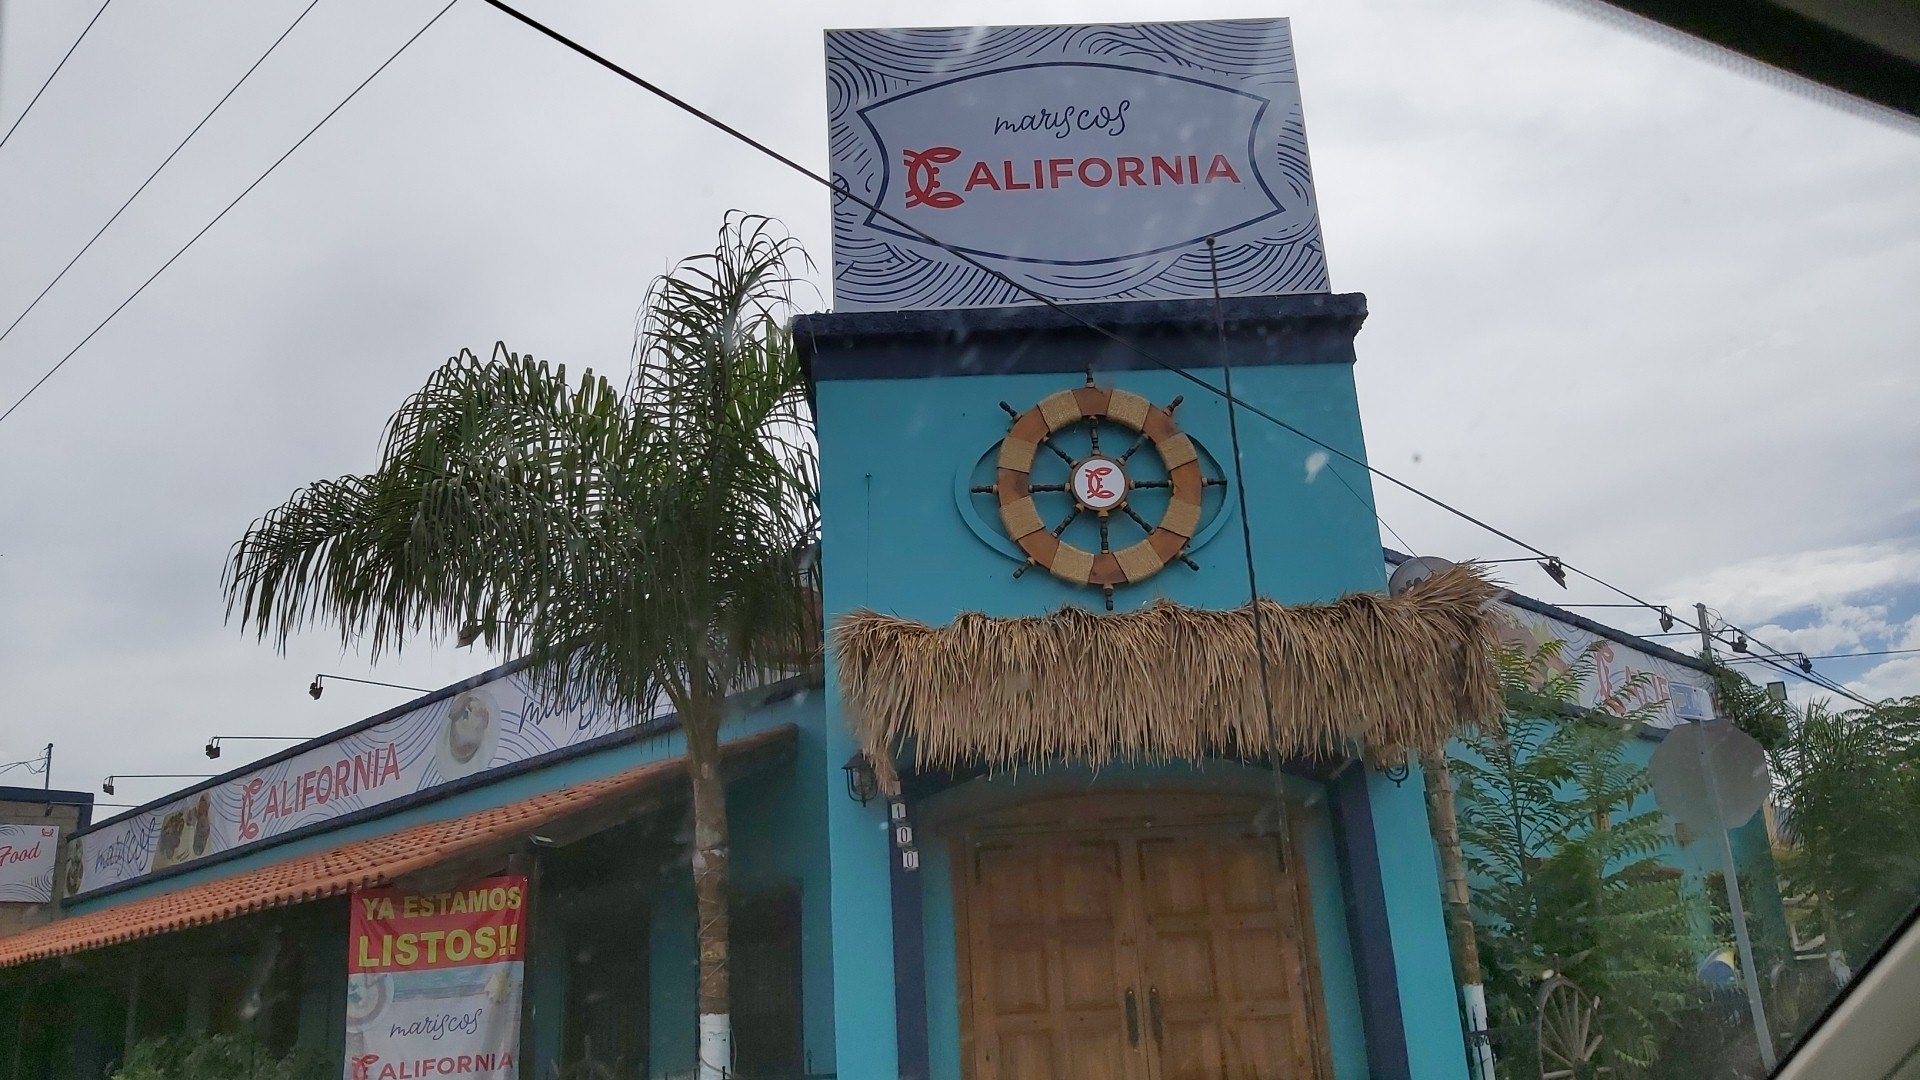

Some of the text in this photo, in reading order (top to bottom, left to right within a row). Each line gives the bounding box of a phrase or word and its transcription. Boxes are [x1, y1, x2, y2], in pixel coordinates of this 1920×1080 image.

[994, 100, 1130, 138] mariscos
[903, 147, 1241, 209] CALIFORNIA
[238, 743, 401, 841] CALIFORNIA
[0, 841, 41, 867] Food
[362, 886, 522, 921] YA ESTAMOS
[358, 924, 518, 968] LISTOS!!
[389, 1008, 482, 1041] mariscos
